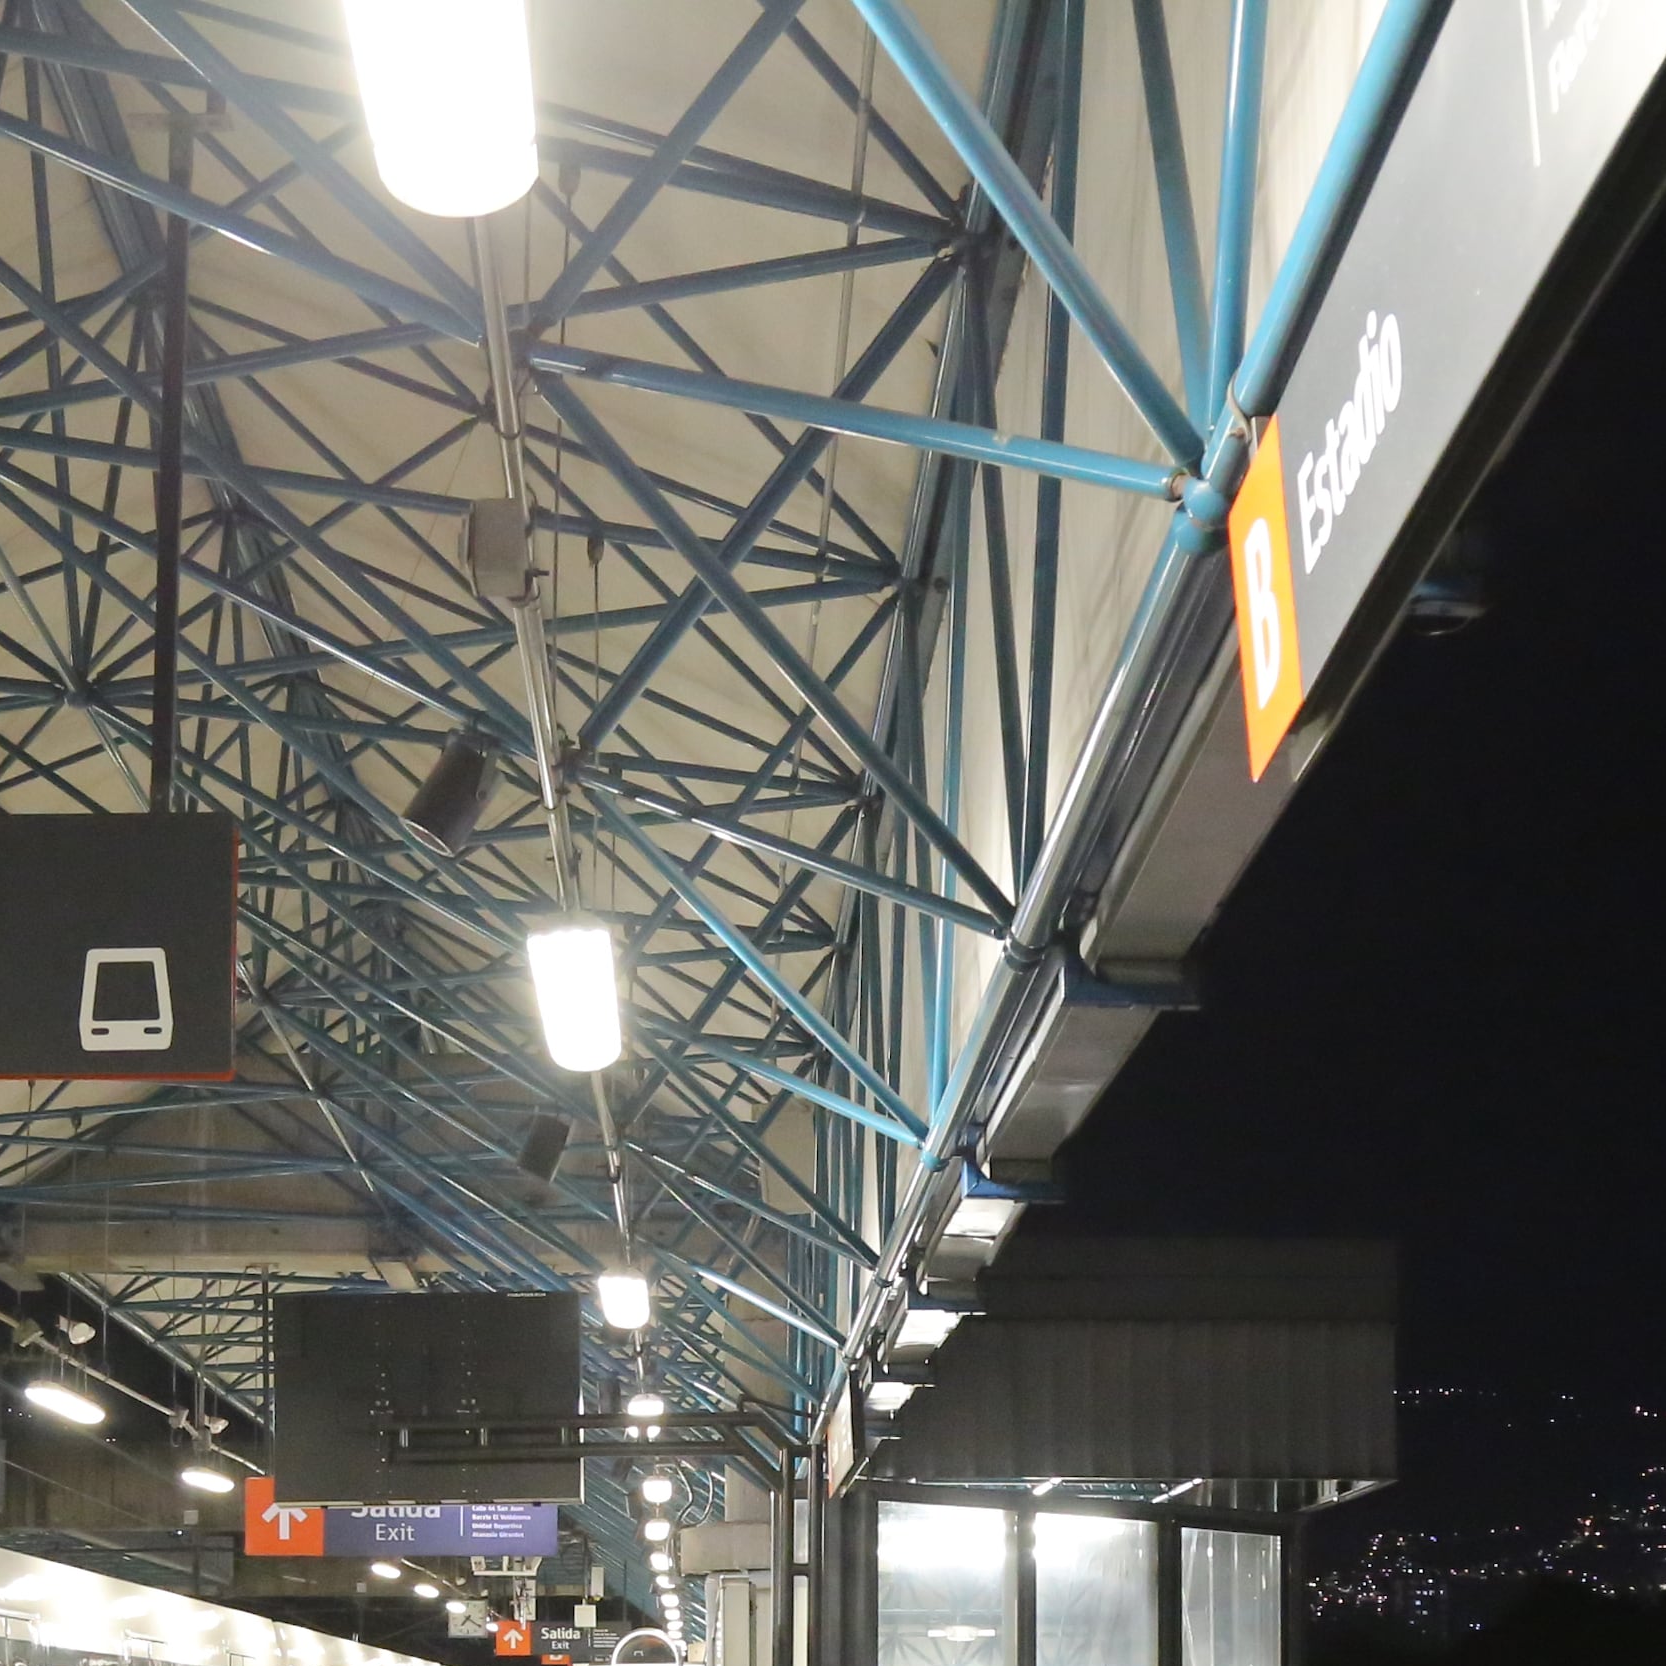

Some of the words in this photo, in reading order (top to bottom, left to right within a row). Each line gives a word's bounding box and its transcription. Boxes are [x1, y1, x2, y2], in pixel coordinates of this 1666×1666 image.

[1297, 310, 1403, 575] Estadio
[1244, 517, 1281, 711] B
[375, 1523, 416, 1541] Exit
[540, 1627, 581, 1640] Salida
[551, 1640, 570, 1650] Exit
